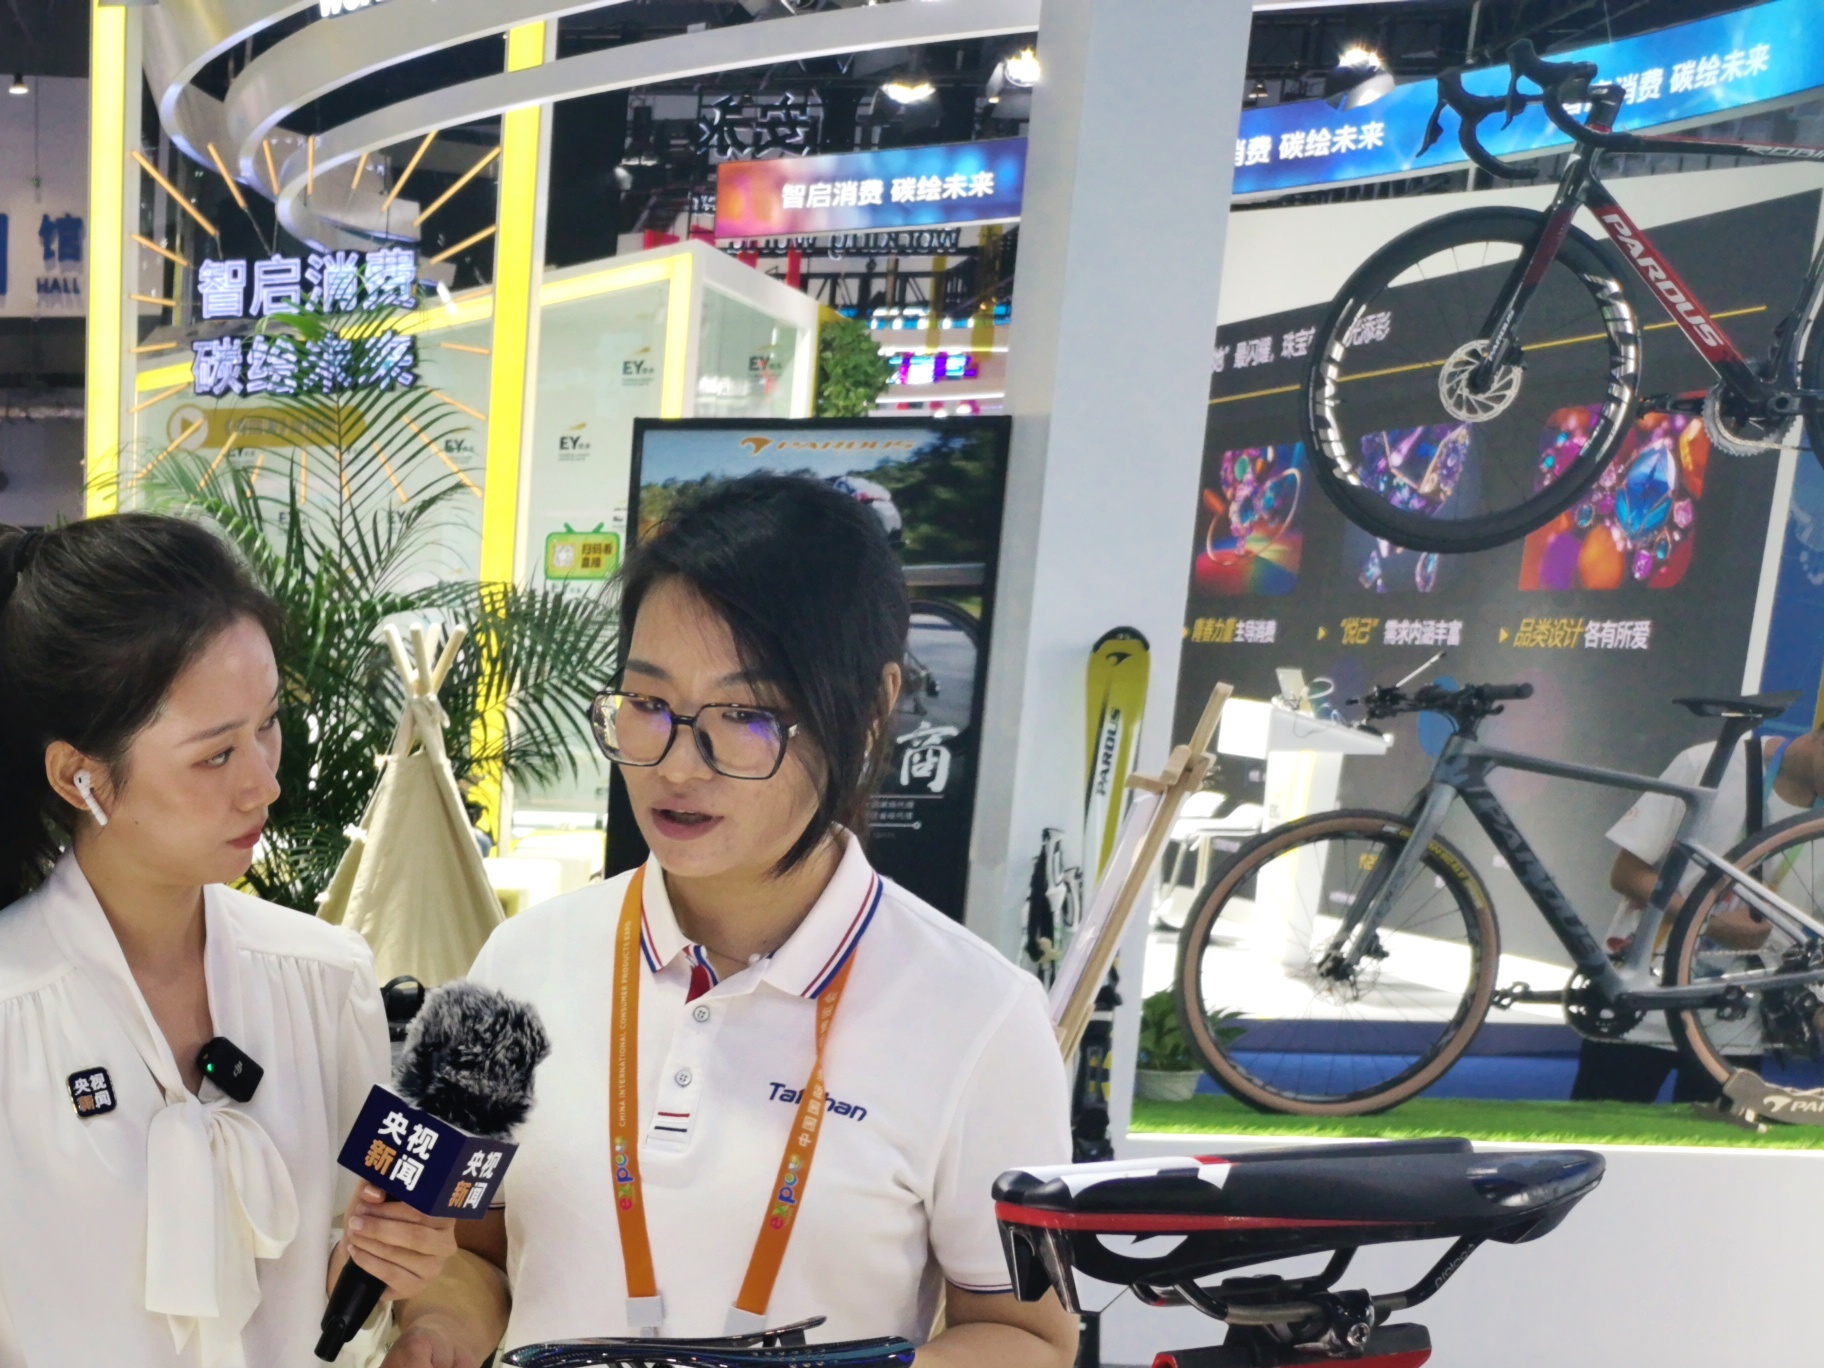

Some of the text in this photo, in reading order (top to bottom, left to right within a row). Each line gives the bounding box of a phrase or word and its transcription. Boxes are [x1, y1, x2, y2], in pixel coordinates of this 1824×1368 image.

[1670, 43, 1770, 93] 碳绘未来
[1278, 121, 1385, 160] 碳绘未来
[781, 171, 995, 209] 智启消费 碳绘未来
[38, 213, 84, 262] 馆
[36, 277, 80, 294] HALL
[197, 248, 417, 319] 智启消费
[1600, 213, 1725, 348] PARDUS
[622, 361, 644, 376] EY
[748, 356, 771, 372] EY
[559, 436, 580, 451] EY
[1512, 618, 1652, 650] 品类设计 各有所爱
[895, 721, 960, 793] 商
[1095, 706, 1122, 796] PARDUS
[619, 986, 629, 1030] CONSUMER
[73, 1071, 107, 1095] 央视
[618, 1033, 628, 1100] INTERNATIONAL
[78, 1091, 112, 1112] 新闻
[618, 1101, 627, 1128] CHINA
[768, 1081, 868, 1122] Taihan
[377, 1109, 440, 1162] 央视
[363, 1138, 425, 1193] 新闻
[466, 1148, 504, 1179] 央视
[448, 1179, 488, 1209] 新闻
[1432, 1241, 1476, 1289] prologo
